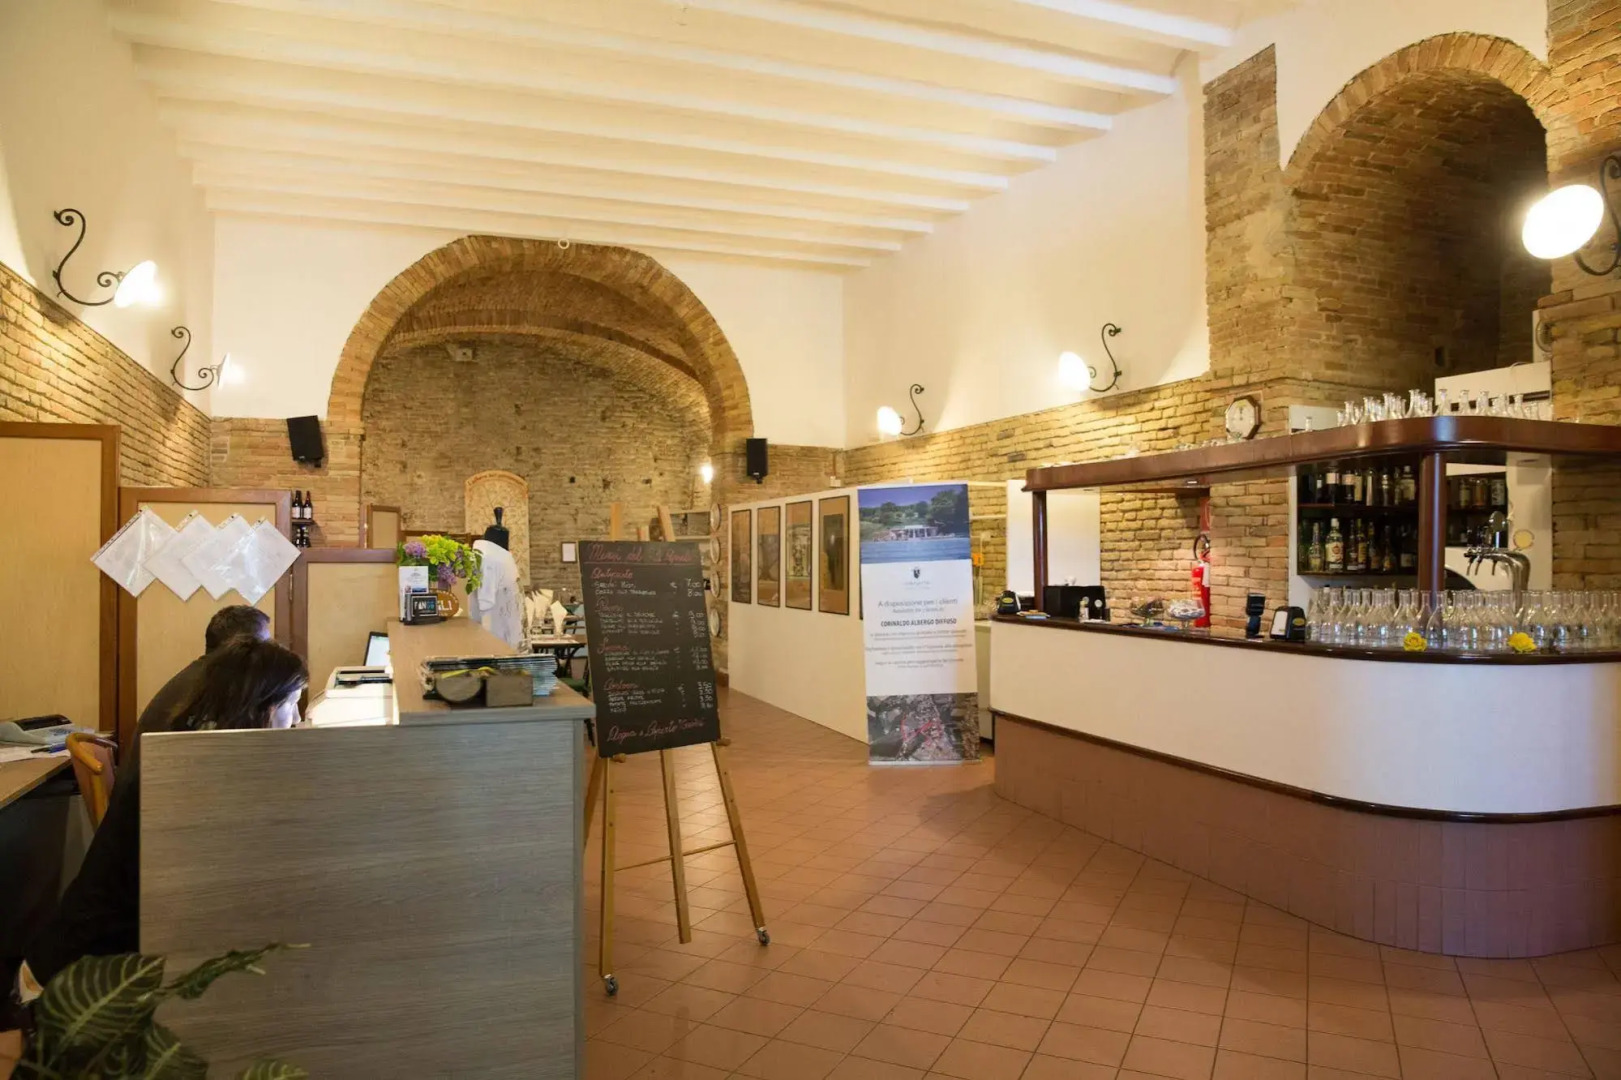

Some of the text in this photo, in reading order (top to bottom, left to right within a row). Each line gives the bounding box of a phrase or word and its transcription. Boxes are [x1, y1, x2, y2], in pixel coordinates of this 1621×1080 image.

[880, 617, 958, 627] CORINALDO ALBERGO DIFFUSO
